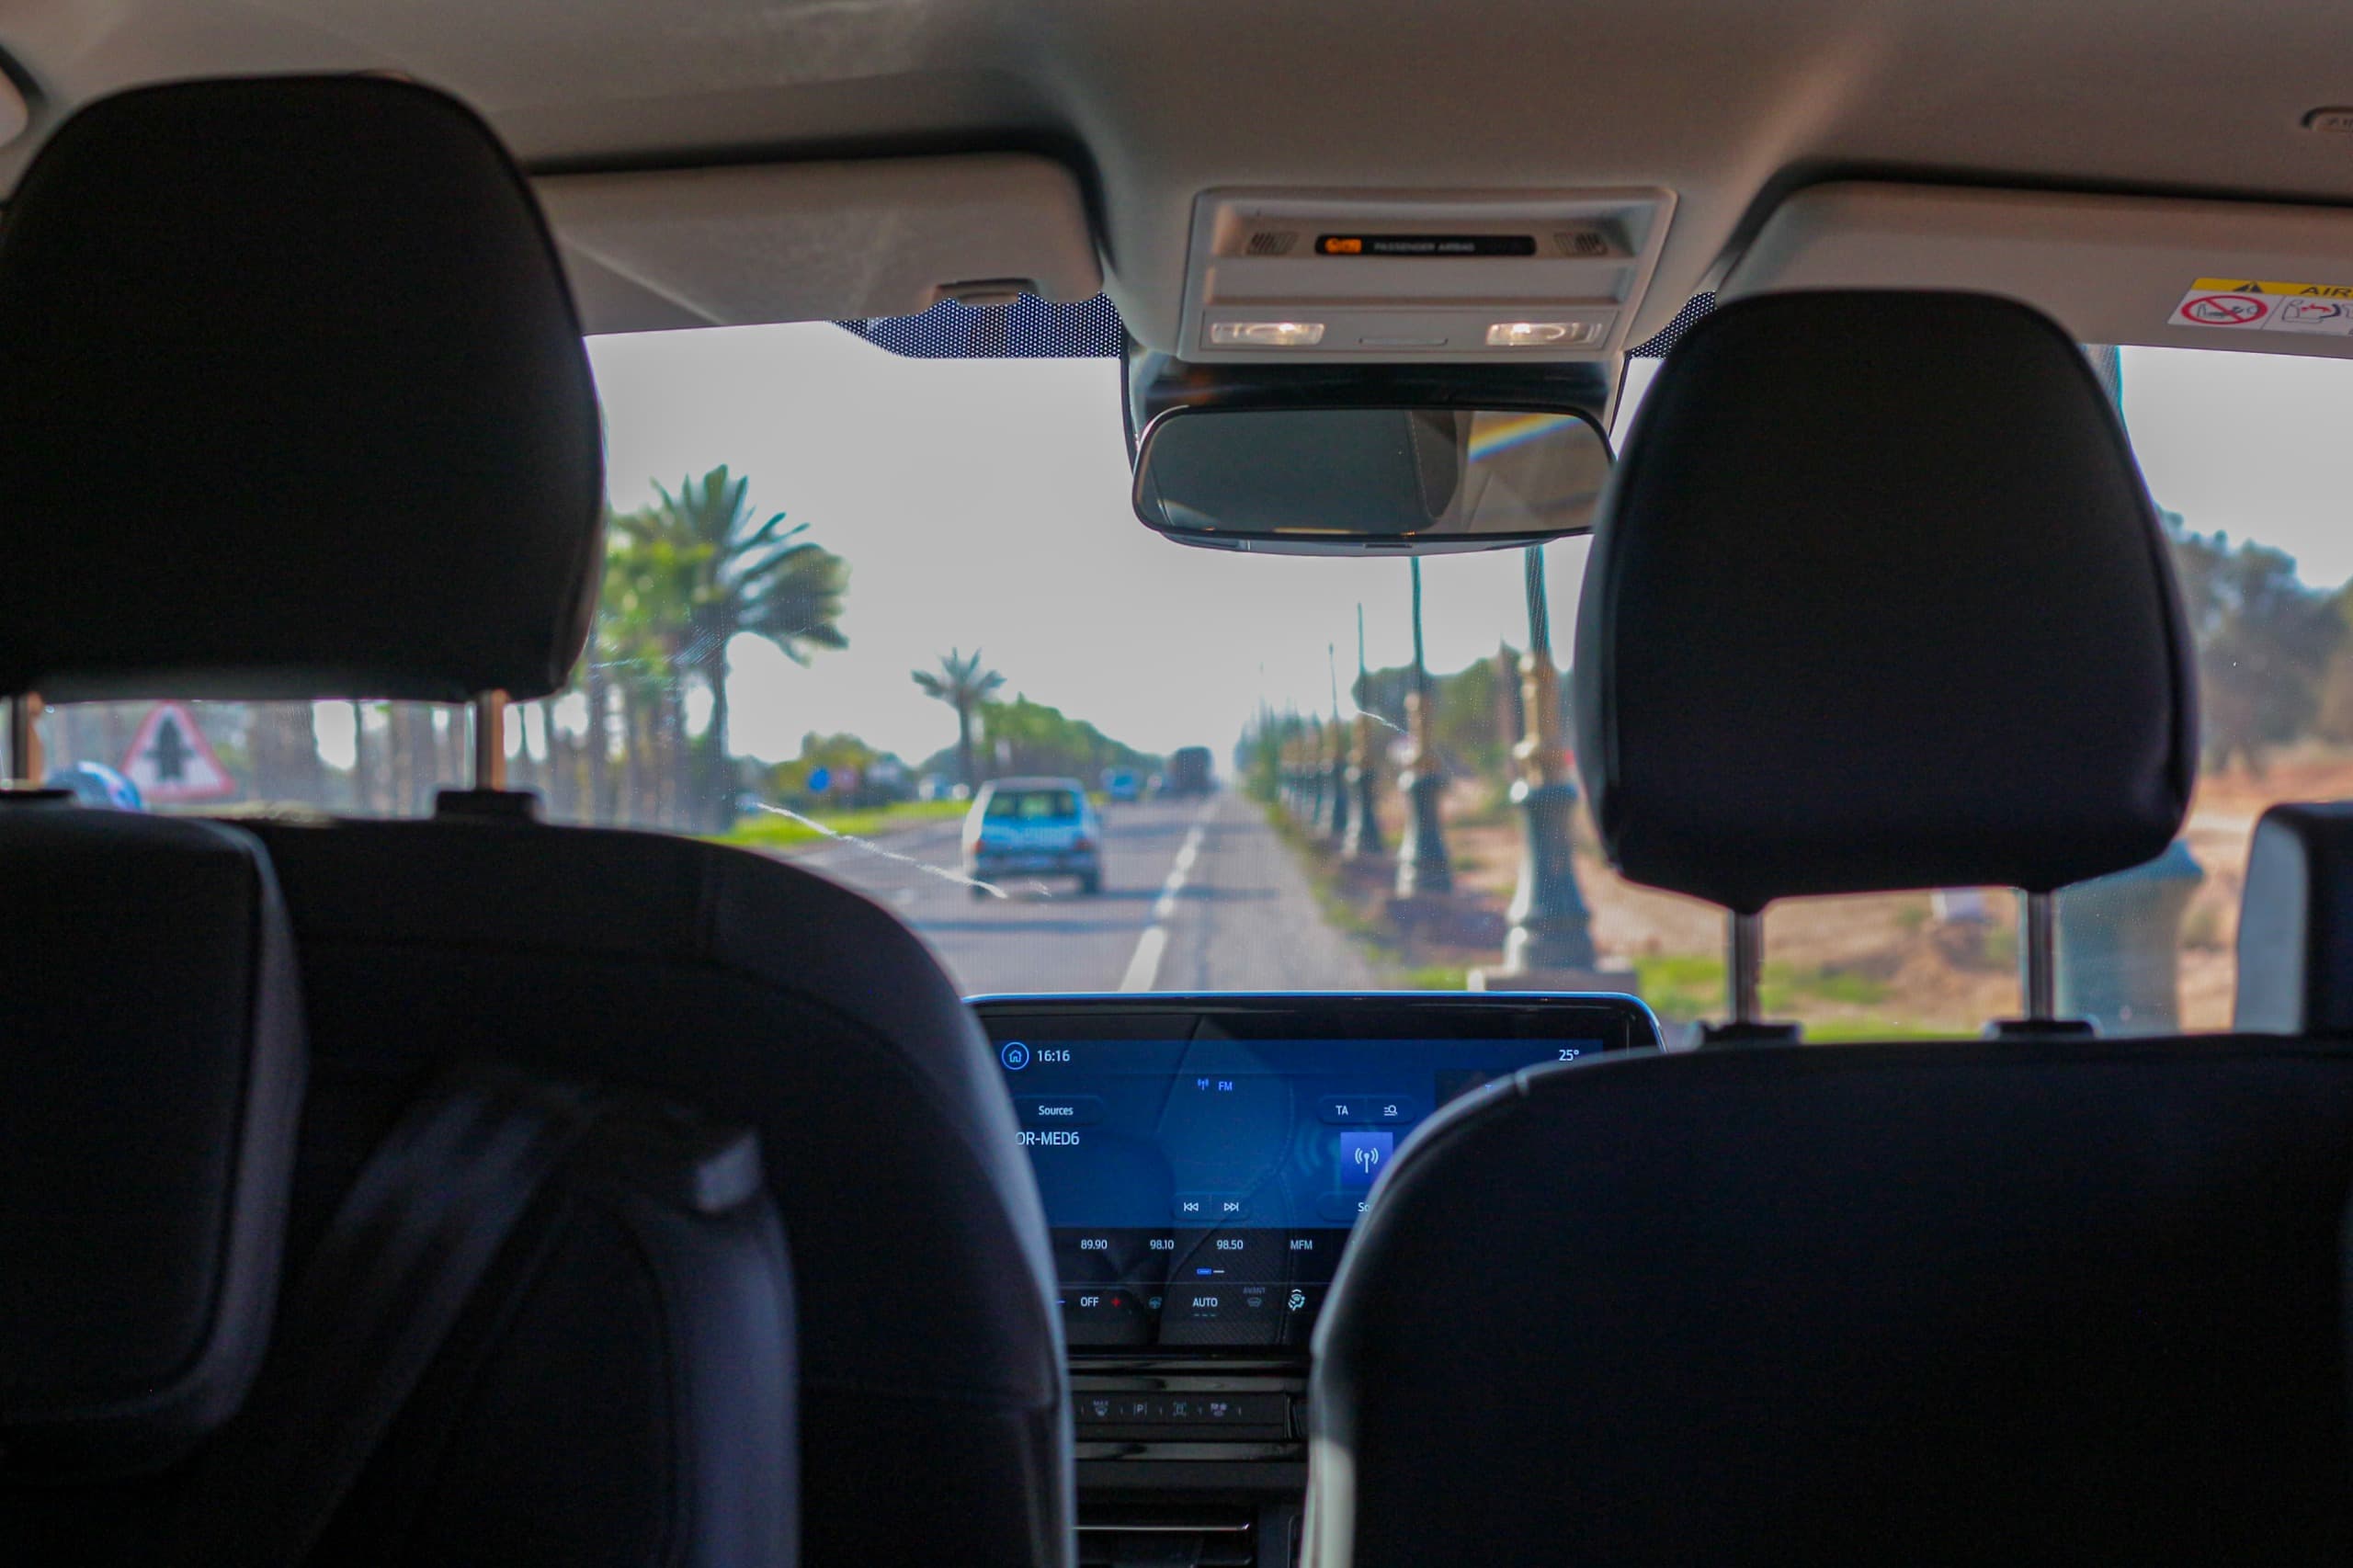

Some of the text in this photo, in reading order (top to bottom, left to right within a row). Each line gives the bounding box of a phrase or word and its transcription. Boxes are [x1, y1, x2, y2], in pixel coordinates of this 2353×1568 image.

[1037, 1050, 1070, 1062] 16:16
[1558, 1049, 1579, 1062] 25°
[1218, 1081, 1233, 1092] FM
[1038, 1105, 1074, 1117] Sources
[1336, 1105, 1348, 1117] TA
[1080, 1239, 1108, 1251] 89.90
[1149, 1239, 1175, 1251] 98.10
[1216, 1239, 1244, 1251] 98.50
[1290, 1239, 1313, 1251] MFM
[1080, 1296, 1099, 1308] OFF
[1192, 1296, 1219, 1308] AUTO
